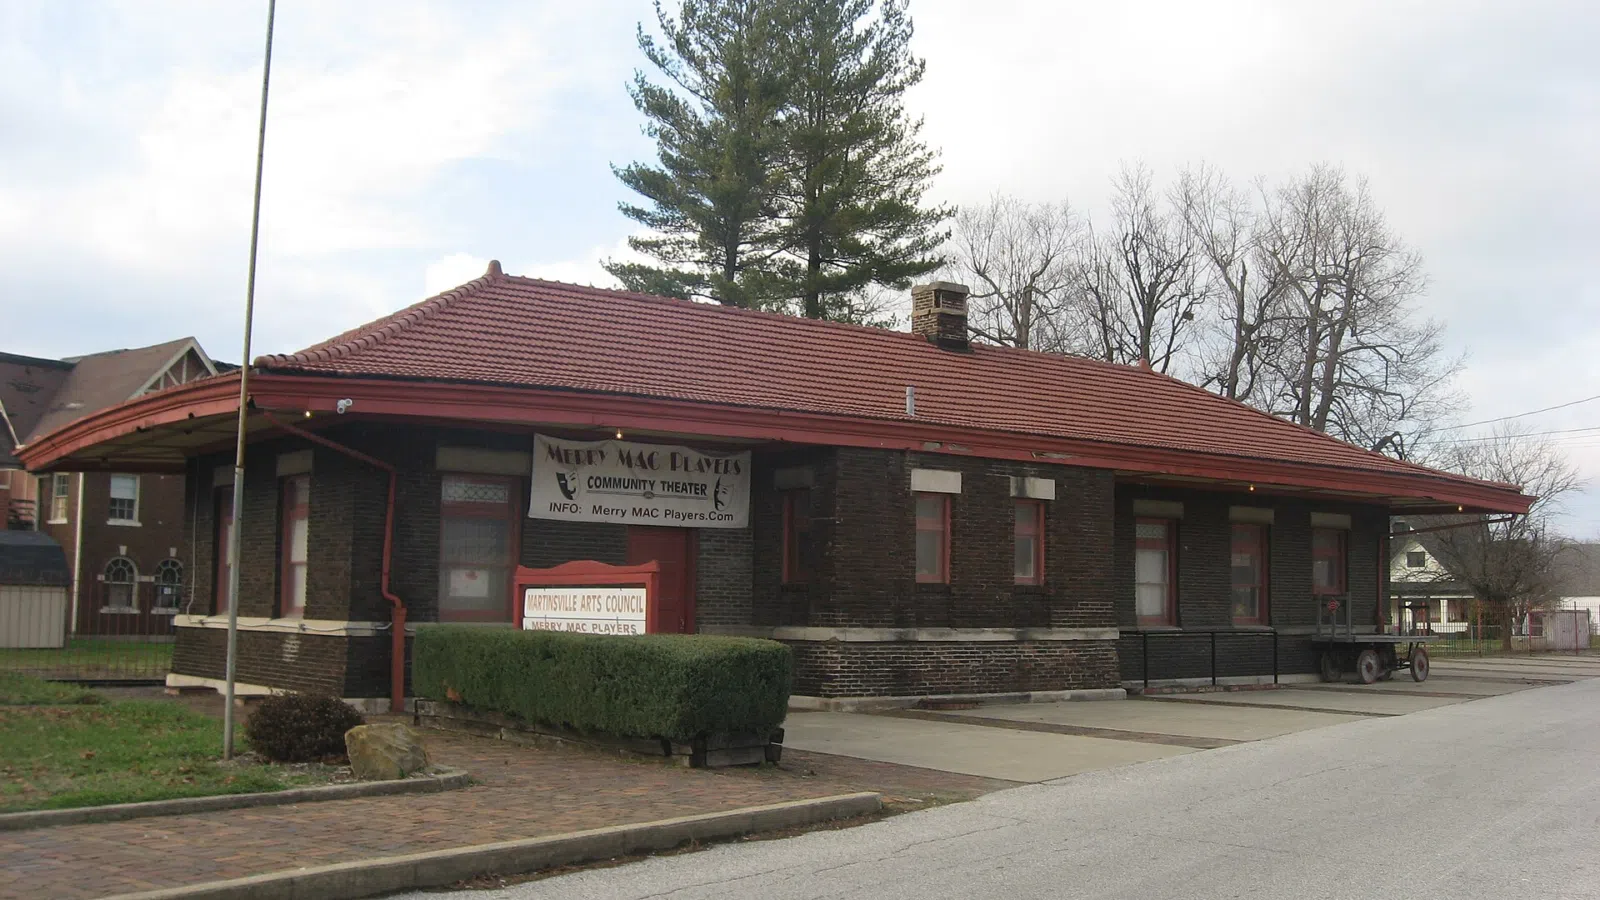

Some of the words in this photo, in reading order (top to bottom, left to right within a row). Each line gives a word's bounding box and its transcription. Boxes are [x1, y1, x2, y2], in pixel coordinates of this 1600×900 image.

[545, 444, 608, 466] MERRY
[616, 448, 660, 471] MAC
[670, 452, 741, 475] PLAYERS
[587, 475, 656, 491] COMMUNITY
[660, 480, 708, 496] THEATER
[549, 503, 582, 514] INFO:
[592, 505, 627, 518] Merry
[632, 507, 659, 518] MAC
[664, 509, 734, 521] Players.Com
[527, 594, 577, 612] MARTINSVILLE
[580, 595, 602, 612] ARTS
[605, 595, 644, 613] COUNCIL
[532, 621, 562, 631] MERRY
[566, 623, 587, 632] MAC
[592, 623, 637, 634] PLAYERS
